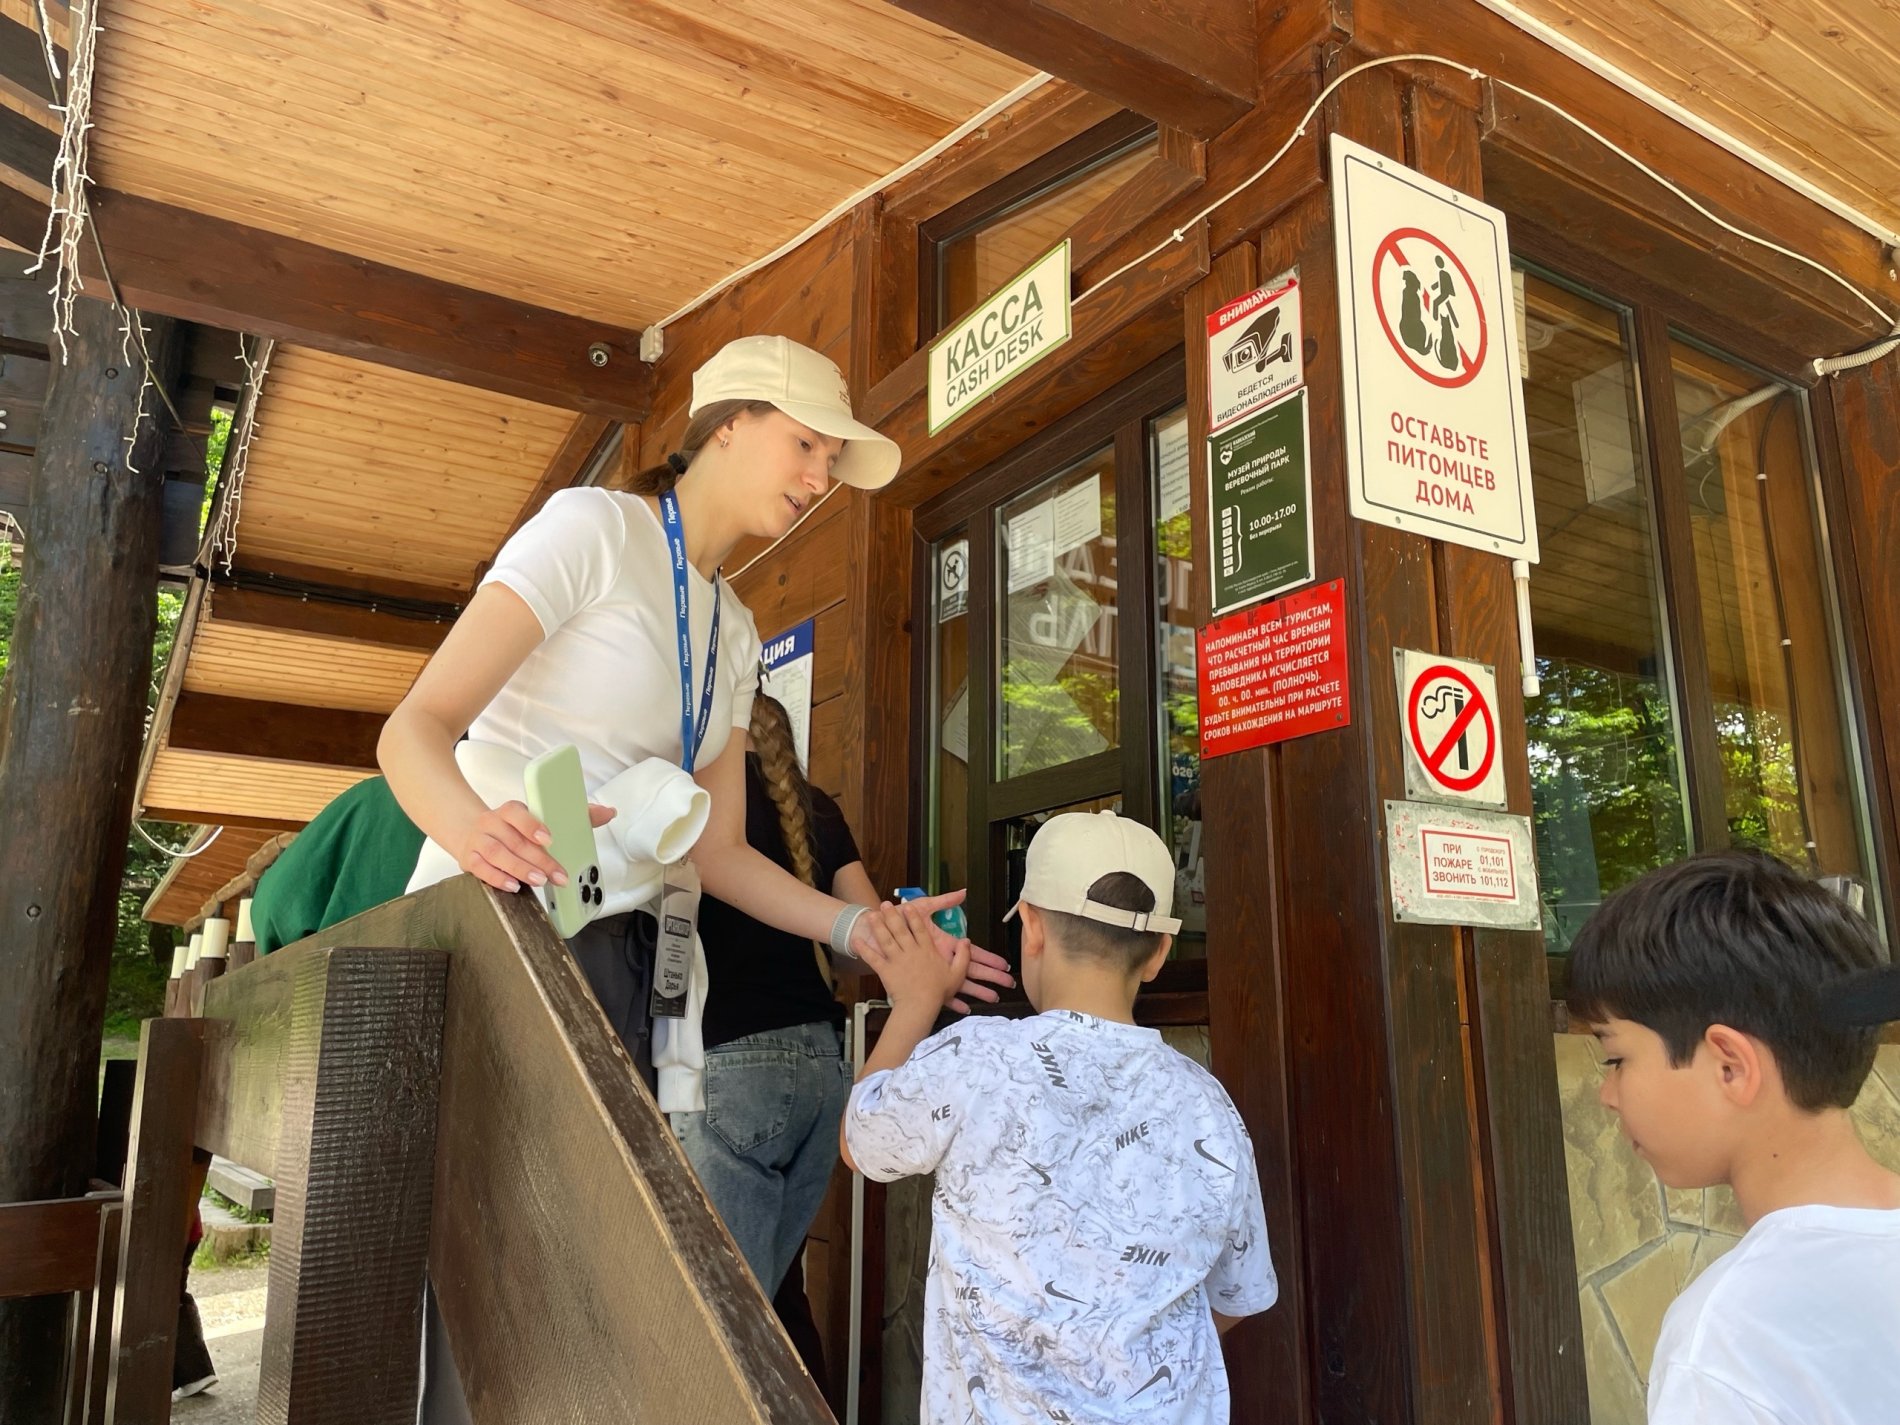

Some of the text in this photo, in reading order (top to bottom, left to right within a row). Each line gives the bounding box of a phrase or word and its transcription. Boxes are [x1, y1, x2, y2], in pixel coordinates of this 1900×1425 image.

[946, 280, 1043, 381] КАССА
[946, 320, 1044, 407] CASH DESK
[1216, 374, 1298, 422] ВИДЕОНАБЛЮДЕНИЕ
[1237, 374, 1274, 399] ВЕДЕТСЯ
[1391, 412, 1488, 460] ОСТАВЬТЕ
[1224, 454, 1290, 491] ВЕРЕВОЧНЫЙ ПАРК
[1228, 446, 1286, 480] МУЗЕЙ ПРИРОДЫ
[1388, 440, 1496, 491] ПИТОМЦЕВ
[666, 497, 677, 524] Первые
[1416, 480, 1474, 515] ДОМА
[1249, 504, 1296, 532] 10.00-17.00
[674, 538, 684, 570] Первые
[1206, 602, 1333, 653] НАПОМИНАЕМ ВСЕМ ТУРИСТАМ,
[1208, 618, 1331, 666] ЧТО РАСЧЕТНЫЙ ЧАС ВРЕМЕНИ
[760, 634, 796, 665] ЦИЯ
[1209, 634, 1331, 680] ПРЕБЫВАНИЯ НА ТЕРРИТОРИИ
[1212, 650, 1329, 695] ЗАПОВЕДНИКА ИСЧИСЛЯЕТСЯ
[1255, 687, 1270, 698] мин.
[1273, 670, 1322, 694] (ПОЛНОЧЬ).
[1204, 680, 1340, 726] БУДЬТЕ ВНИМАТЕЛЬНЫ ПРИ РАСЧЕТЕ
[1204, 696, 1342, 741] СРОКОВ НАХОЖДЕНИЯ НА МАРШРУТЕ
[1434, 857, 1473, 870] ПОЖАРЕ
[1442, 843, 1462, 854] ПРИ
[1480, 855, 1504, 867] 01,101
[1432, 872, 1476, 884] ЗВОНИТЬ
[1480, 876, 1508, 888] 101,112
[1030, 1042, 1068, 1088] NIKE
[1115, 1121, 1150, 1151] NIKE
[1120, 1246, 1170, 1267] NIKE
